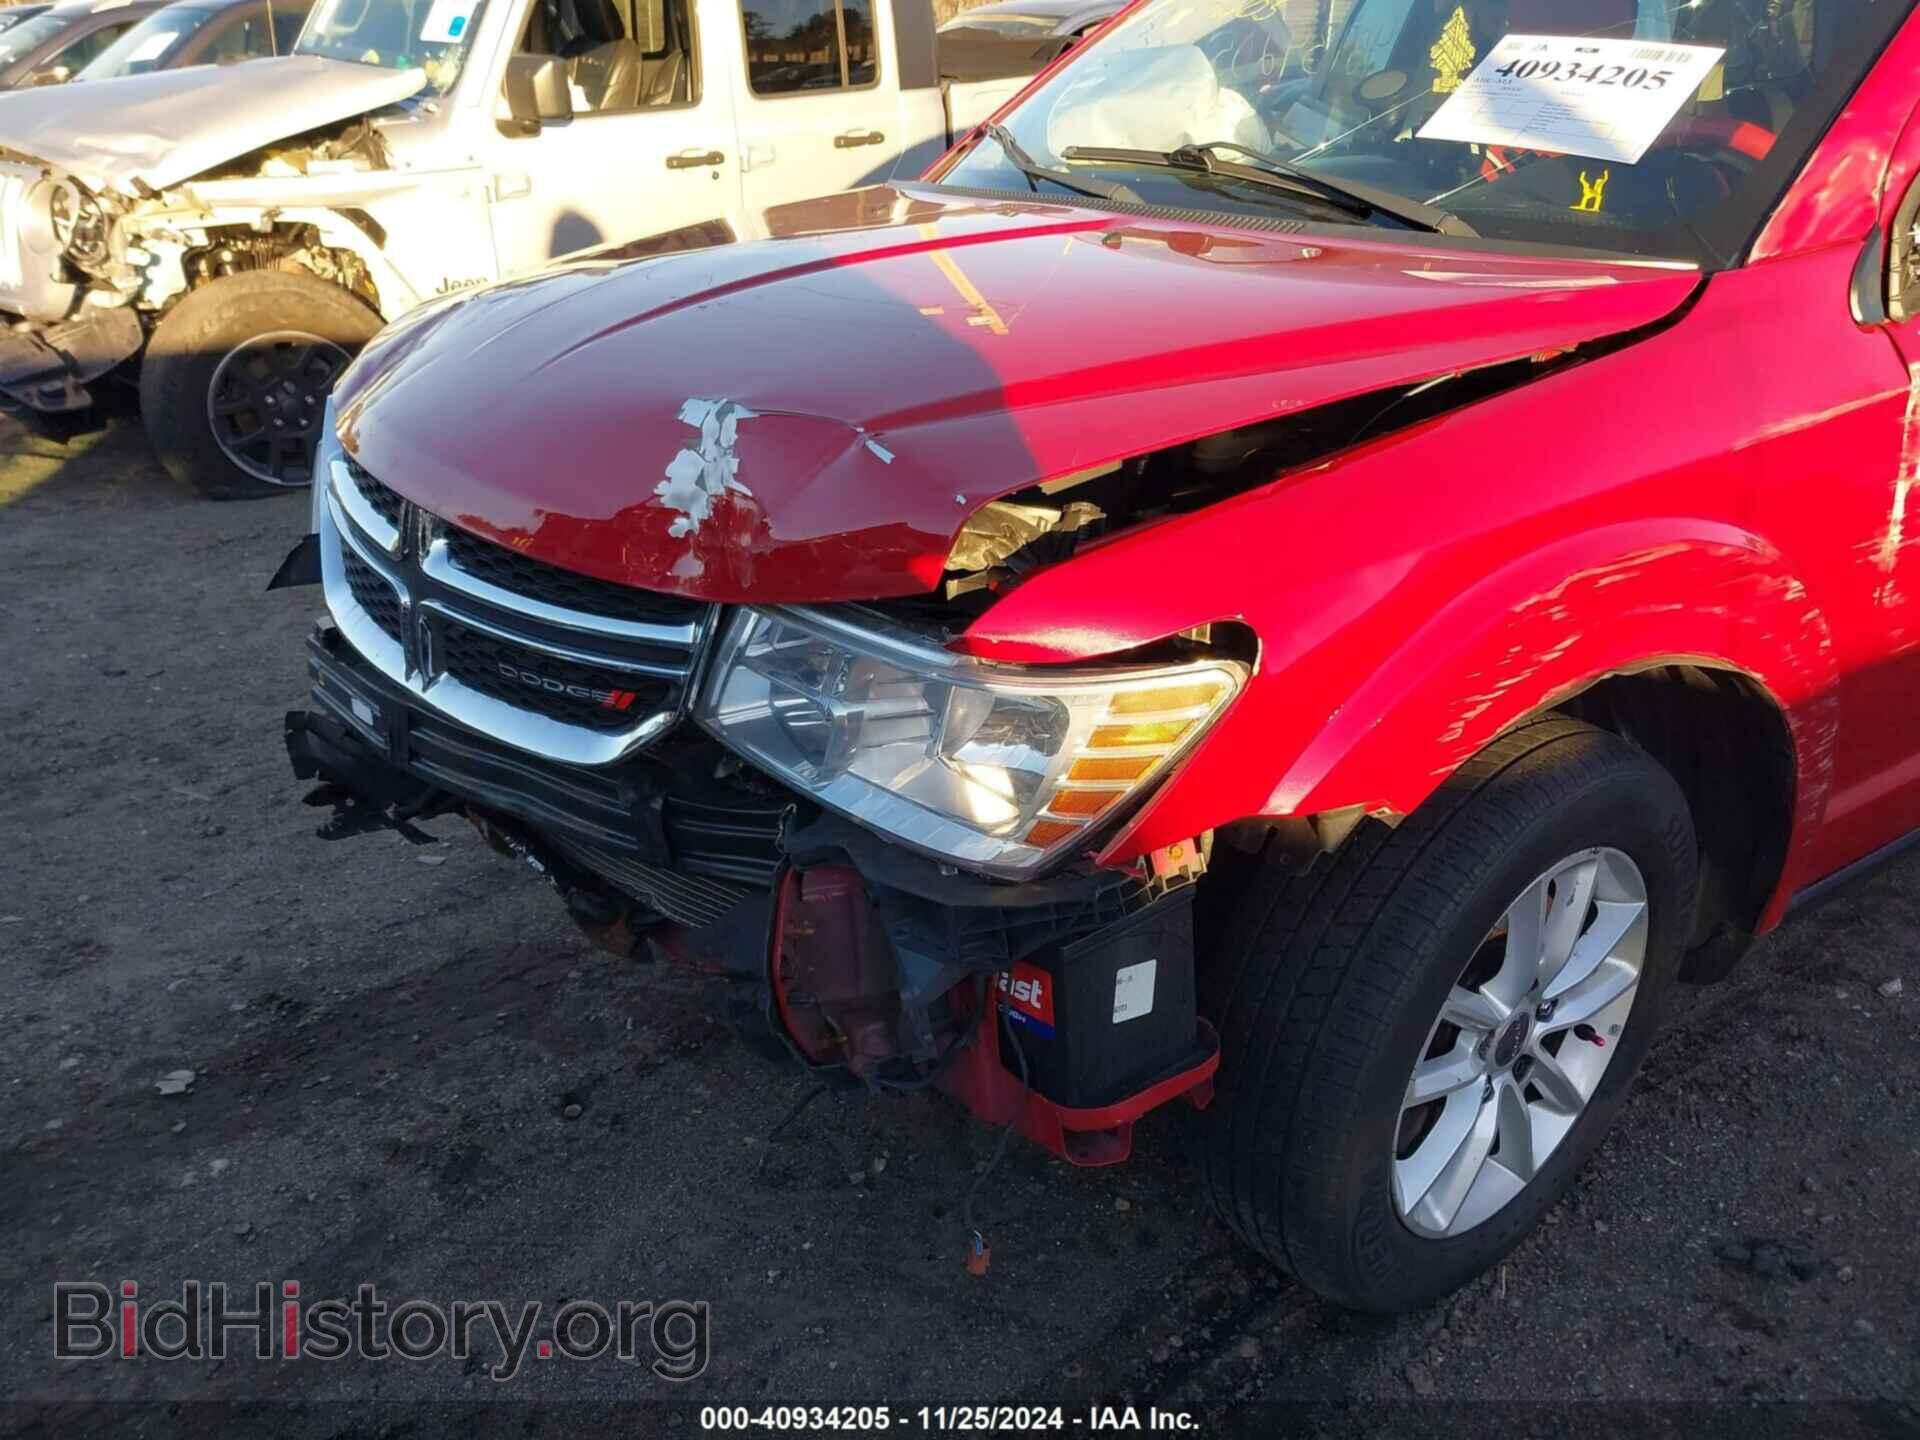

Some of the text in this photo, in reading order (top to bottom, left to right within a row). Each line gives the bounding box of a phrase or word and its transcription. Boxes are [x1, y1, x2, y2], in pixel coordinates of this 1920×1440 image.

[1495, 58, 1674, 91] 40934205
[497, 662, 616, 705] DODGE
[992, 969, 1043, 1009] ast
